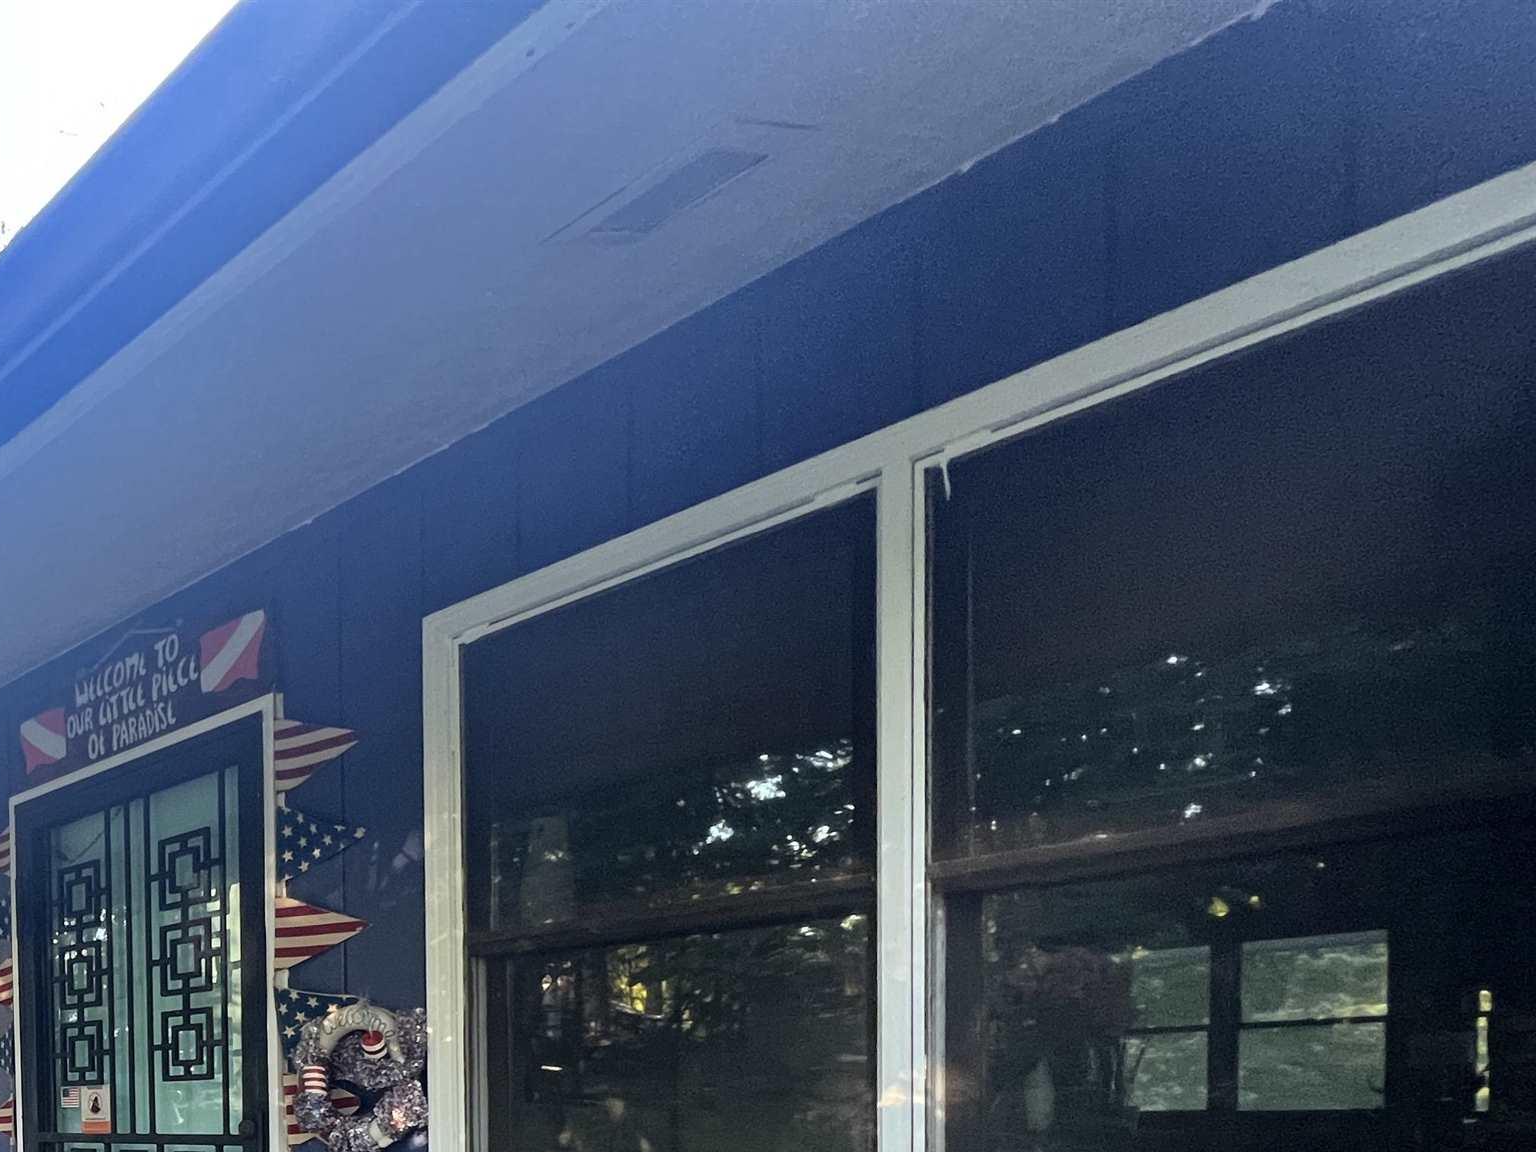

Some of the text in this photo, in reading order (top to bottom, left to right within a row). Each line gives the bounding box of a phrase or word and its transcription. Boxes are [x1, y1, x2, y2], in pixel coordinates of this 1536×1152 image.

[75, 634, 179, 707] WELCOME TO
[67, 706, 93, 738] OUR
[111, 701, 176, 750] PARADISE
